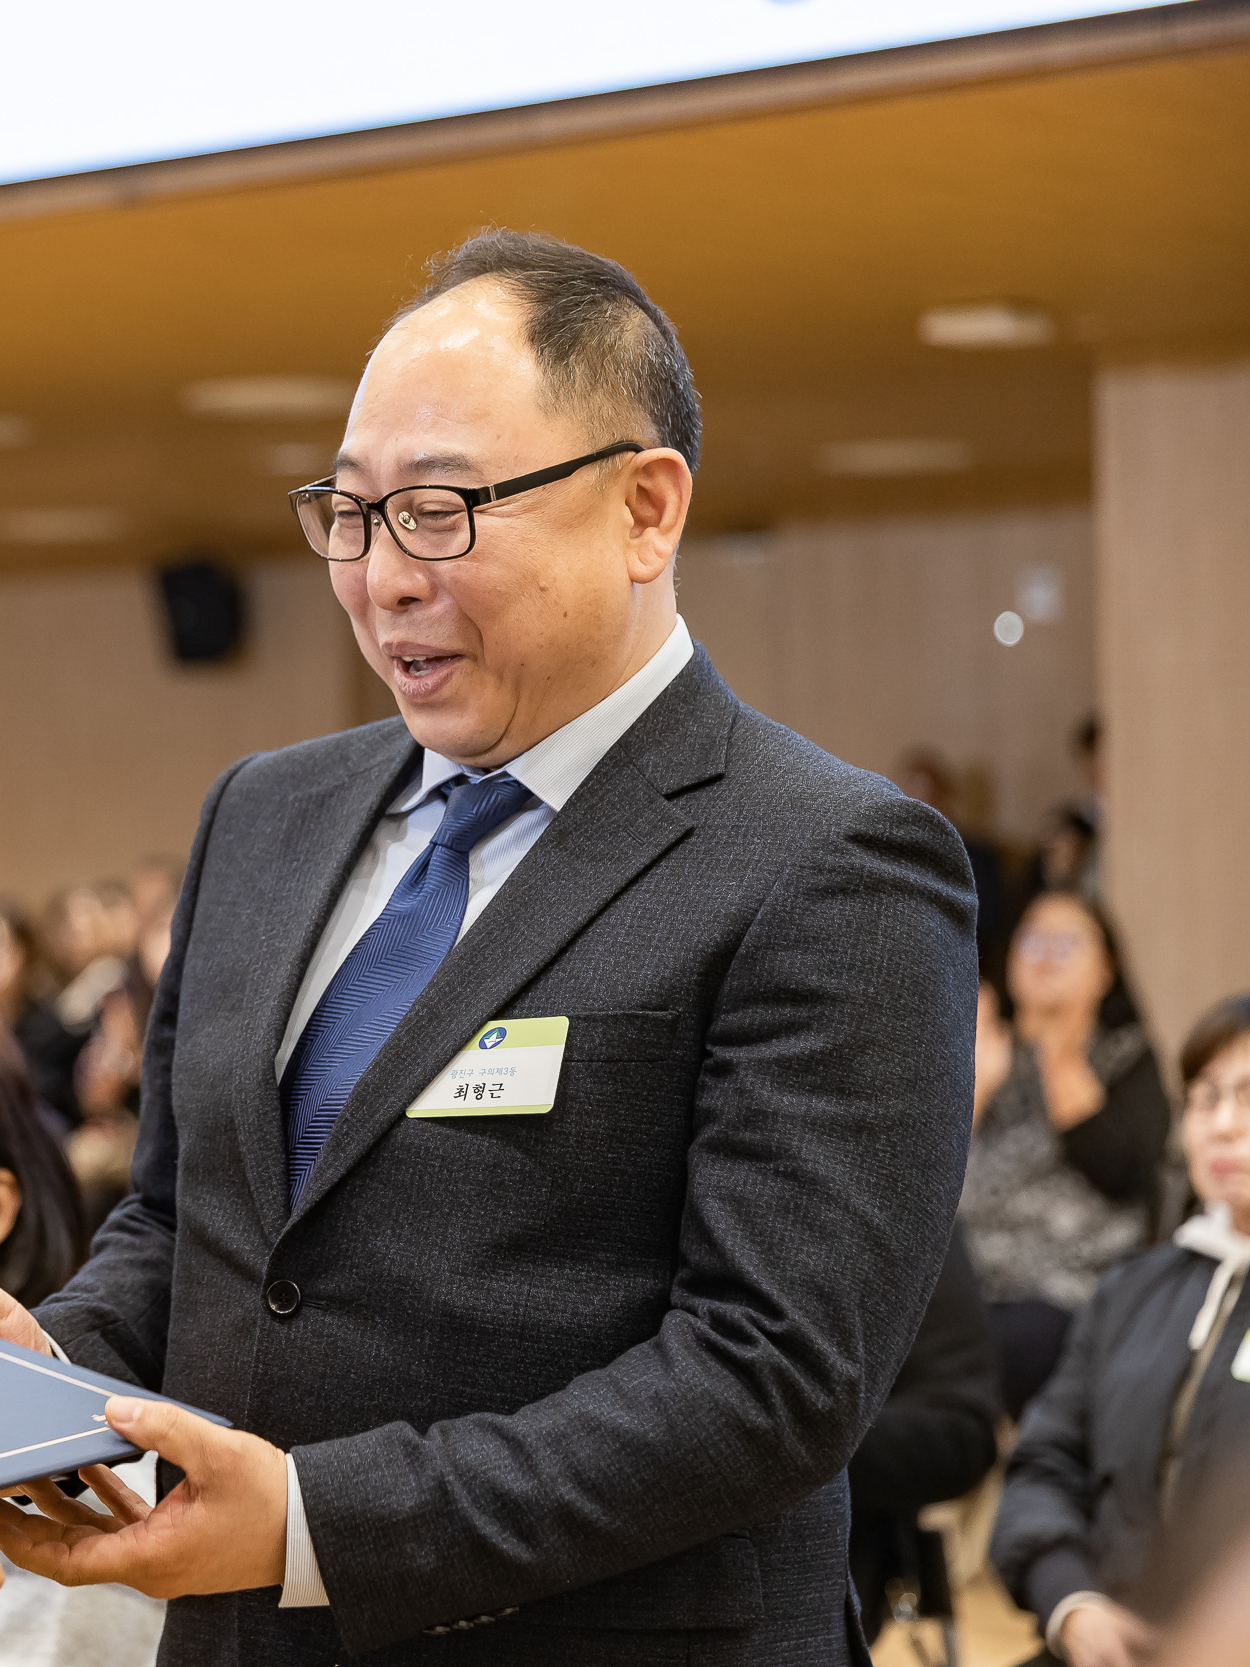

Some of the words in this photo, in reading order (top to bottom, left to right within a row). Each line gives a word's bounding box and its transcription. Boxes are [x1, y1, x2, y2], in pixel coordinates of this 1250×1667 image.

[450, 1069, 475, 1079] 광진구
[479, 1066, 517, 1077] 구의제3동
[453, 1082, 505, 1101] 최형근
